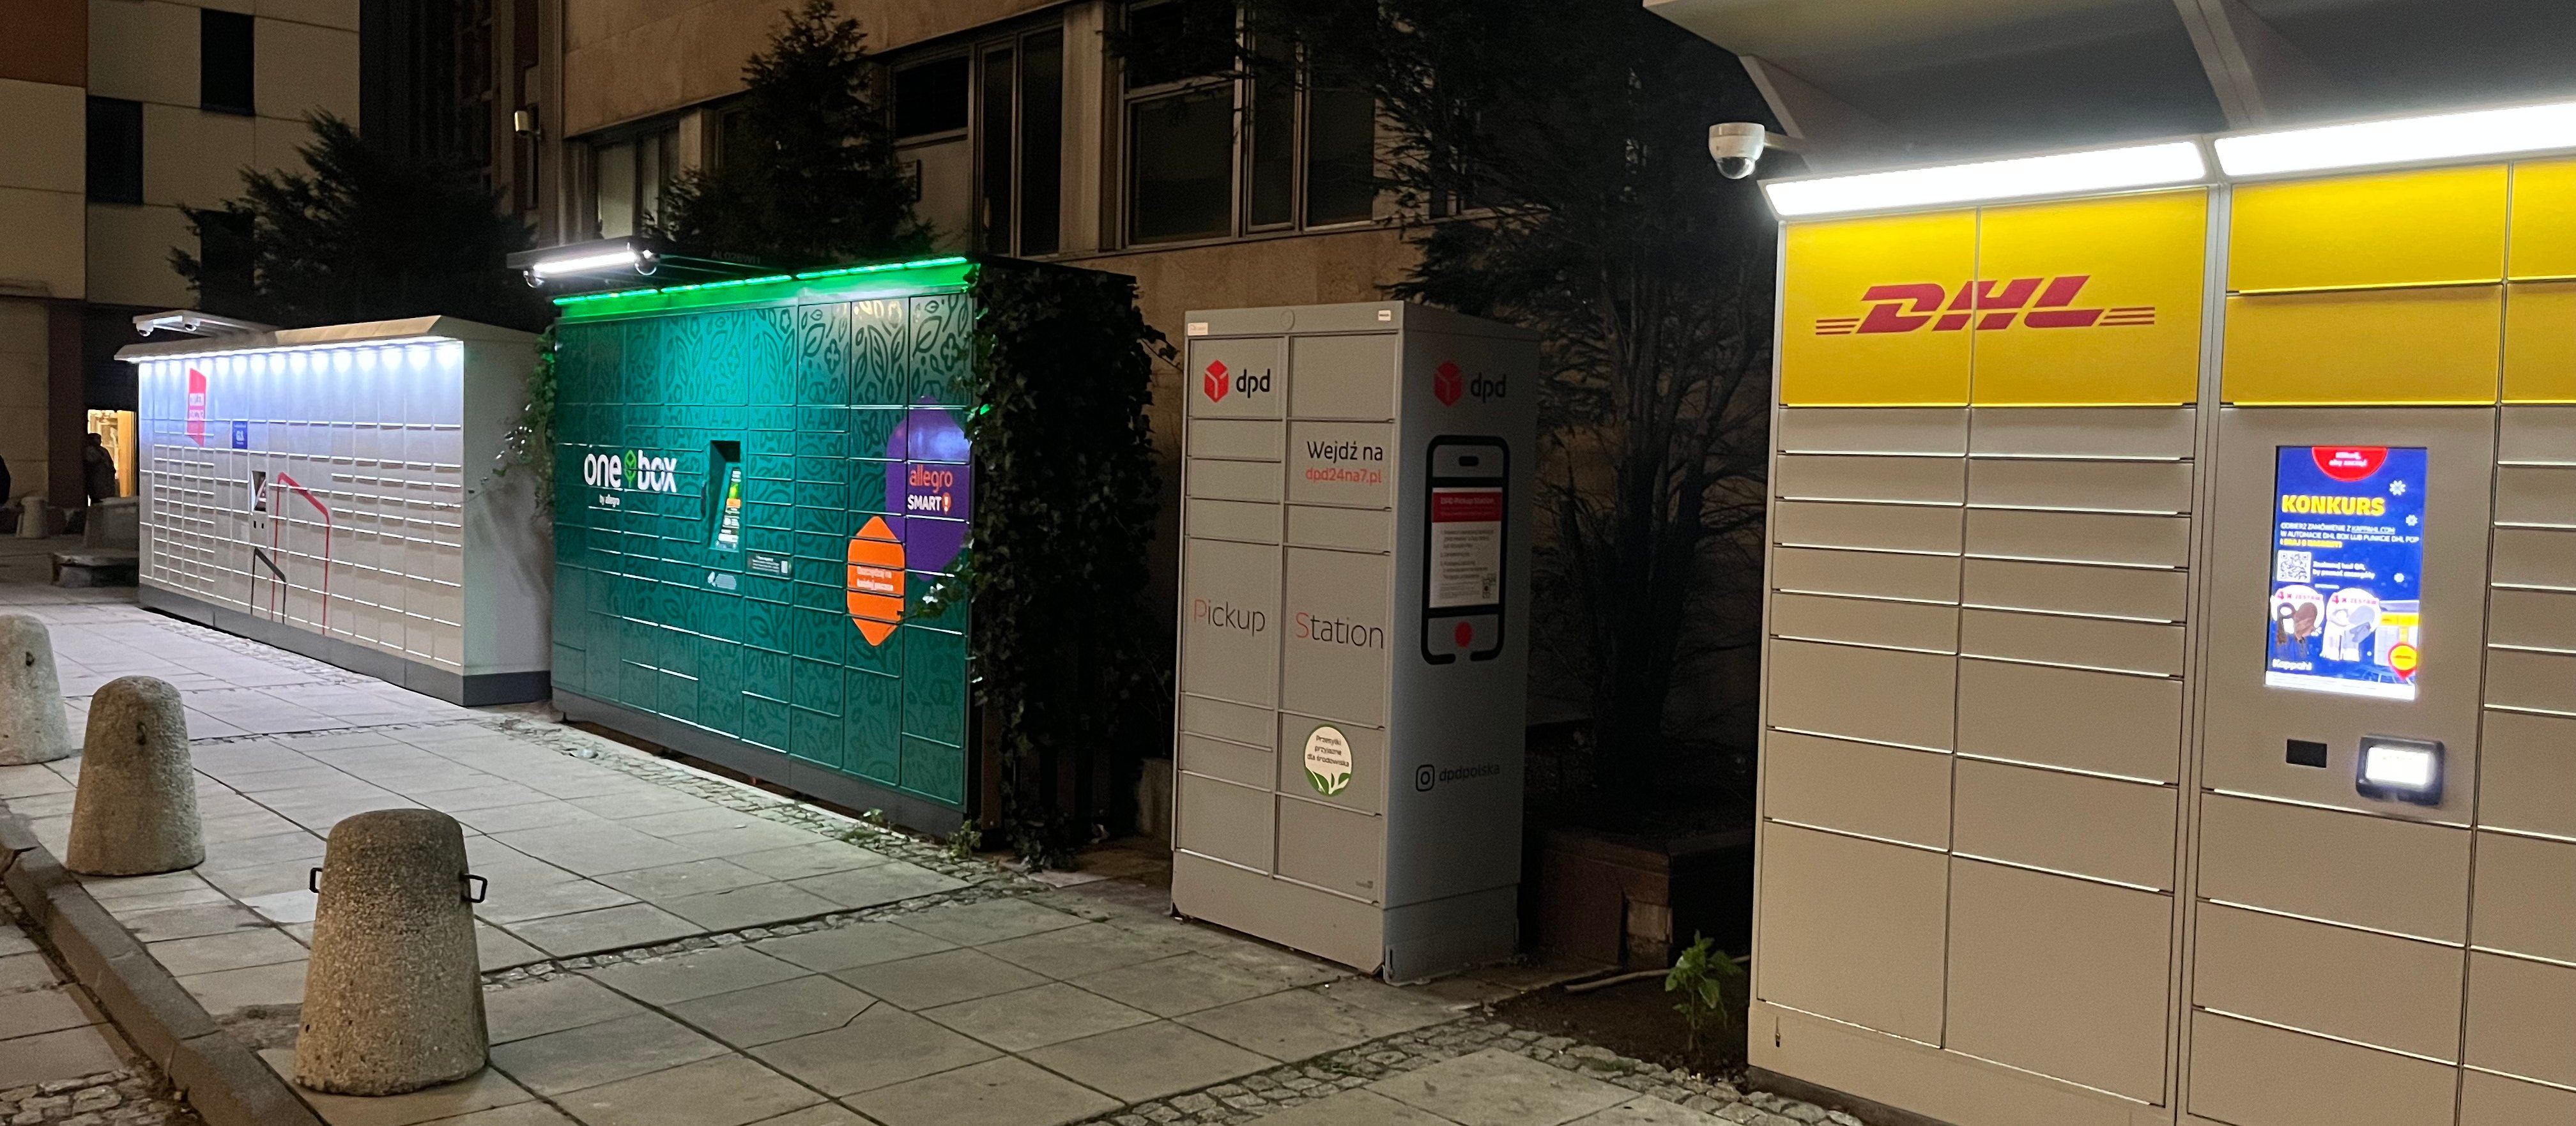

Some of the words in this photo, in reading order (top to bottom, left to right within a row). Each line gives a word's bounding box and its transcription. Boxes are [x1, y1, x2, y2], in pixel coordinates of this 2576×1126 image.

[1856, 275, 2104, 333] DHL
[1236, 369, 1270, 398] dpd
[1470, 372, 1506, 403] dpd
[1307, 441, 1358, 463] Wejdź
[1362, 446, 1383, 461] na
[584, 453, 622, 488] one
[638, 449, 677, 493] box
[909, 464, 953, 493] allegro
[1305, 467, 1383, 484] dpd24na7.pl
[2281, 494, 2386, 516] KONKURS
[2277, 591, 2285, 600] 4
[2332, 595, 2340, 604] 4
[1193, 599, 1266, 637] Pickup
[1295, 612, 1384, 650] Station
[1439, 762, 1500, 784] dpdpolska
